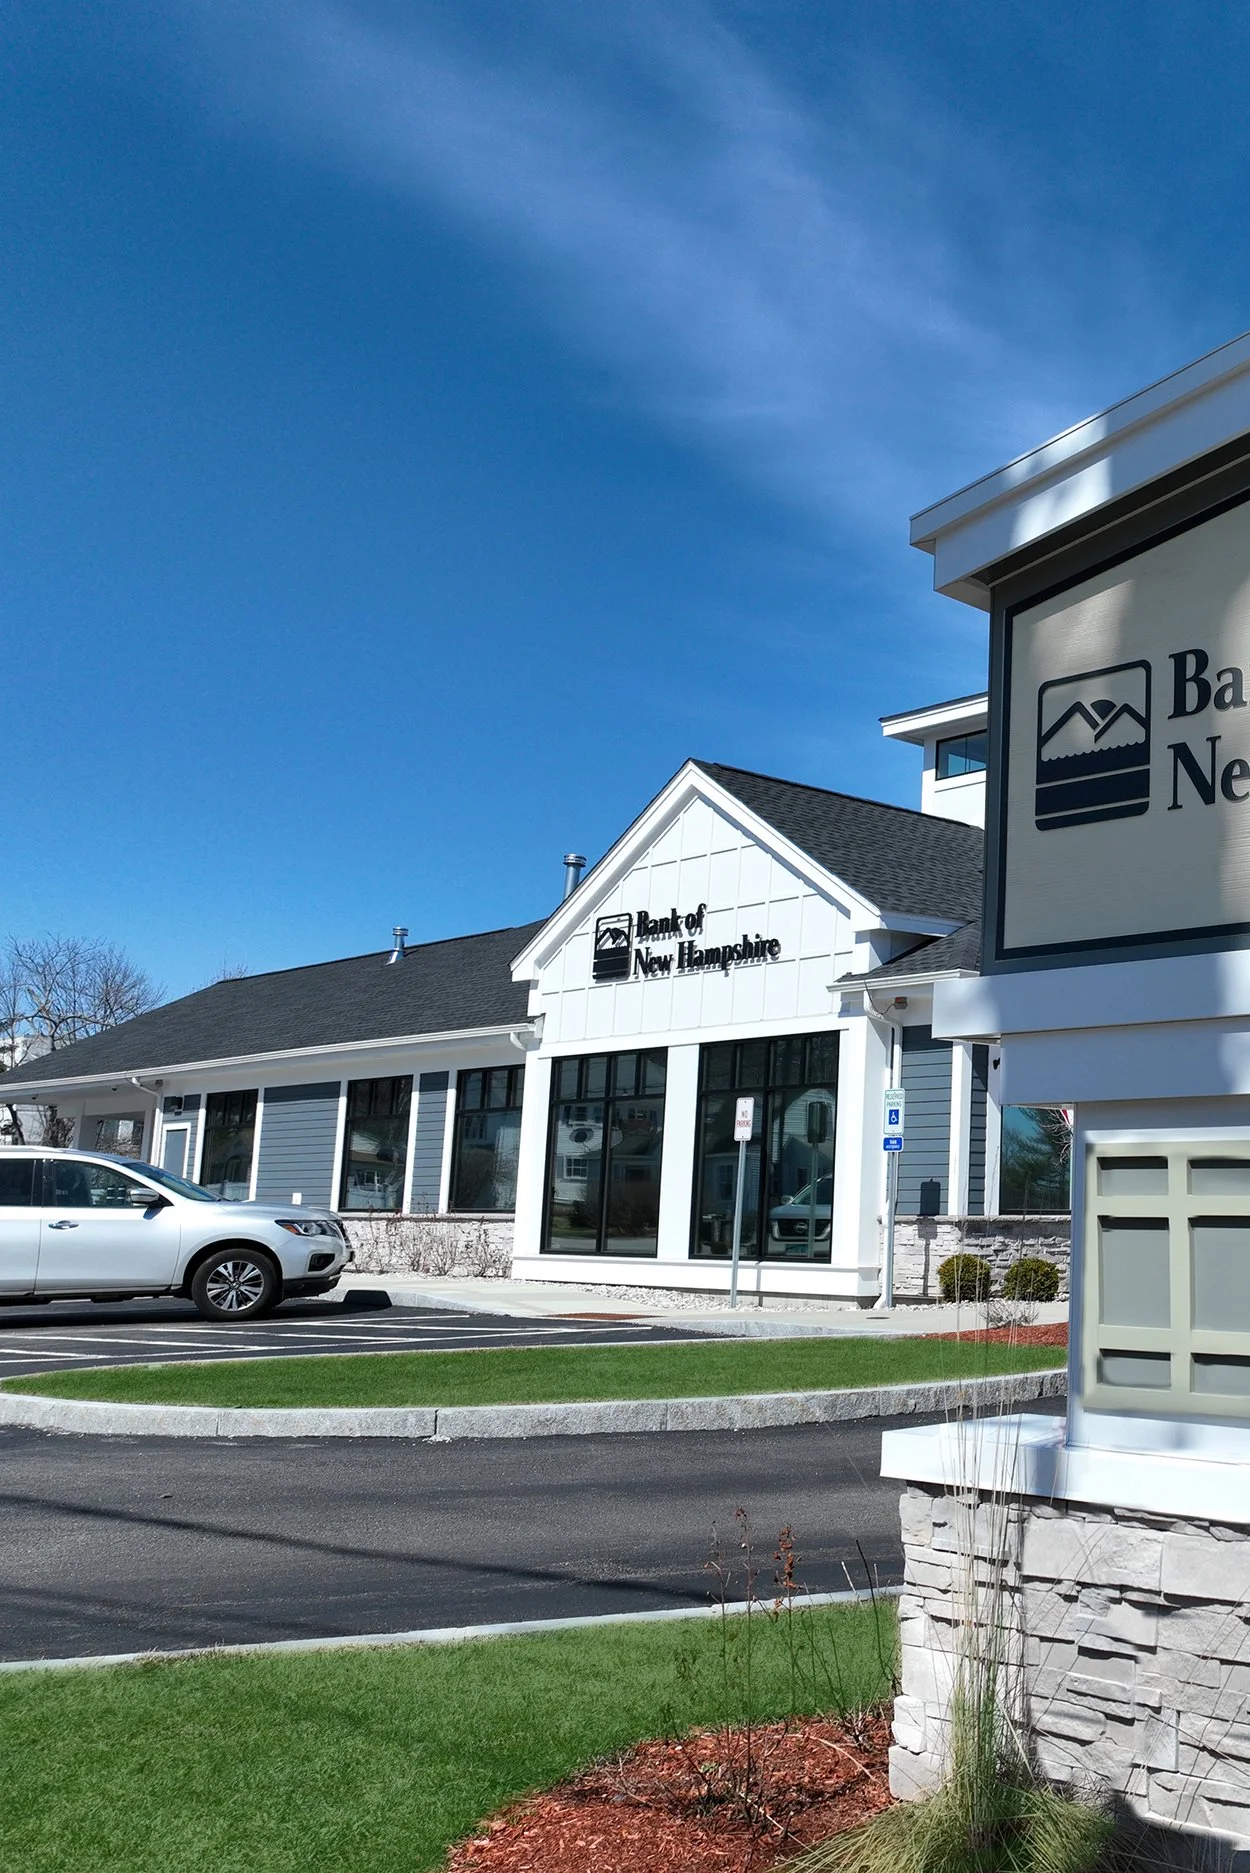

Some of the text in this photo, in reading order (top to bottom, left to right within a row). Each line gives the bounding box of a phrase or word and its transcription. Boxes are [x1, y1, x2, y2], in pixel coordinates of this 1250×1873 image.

[635, 903, 707, 938] Bank of
[633, 933, 781, 976] New Hampshire
